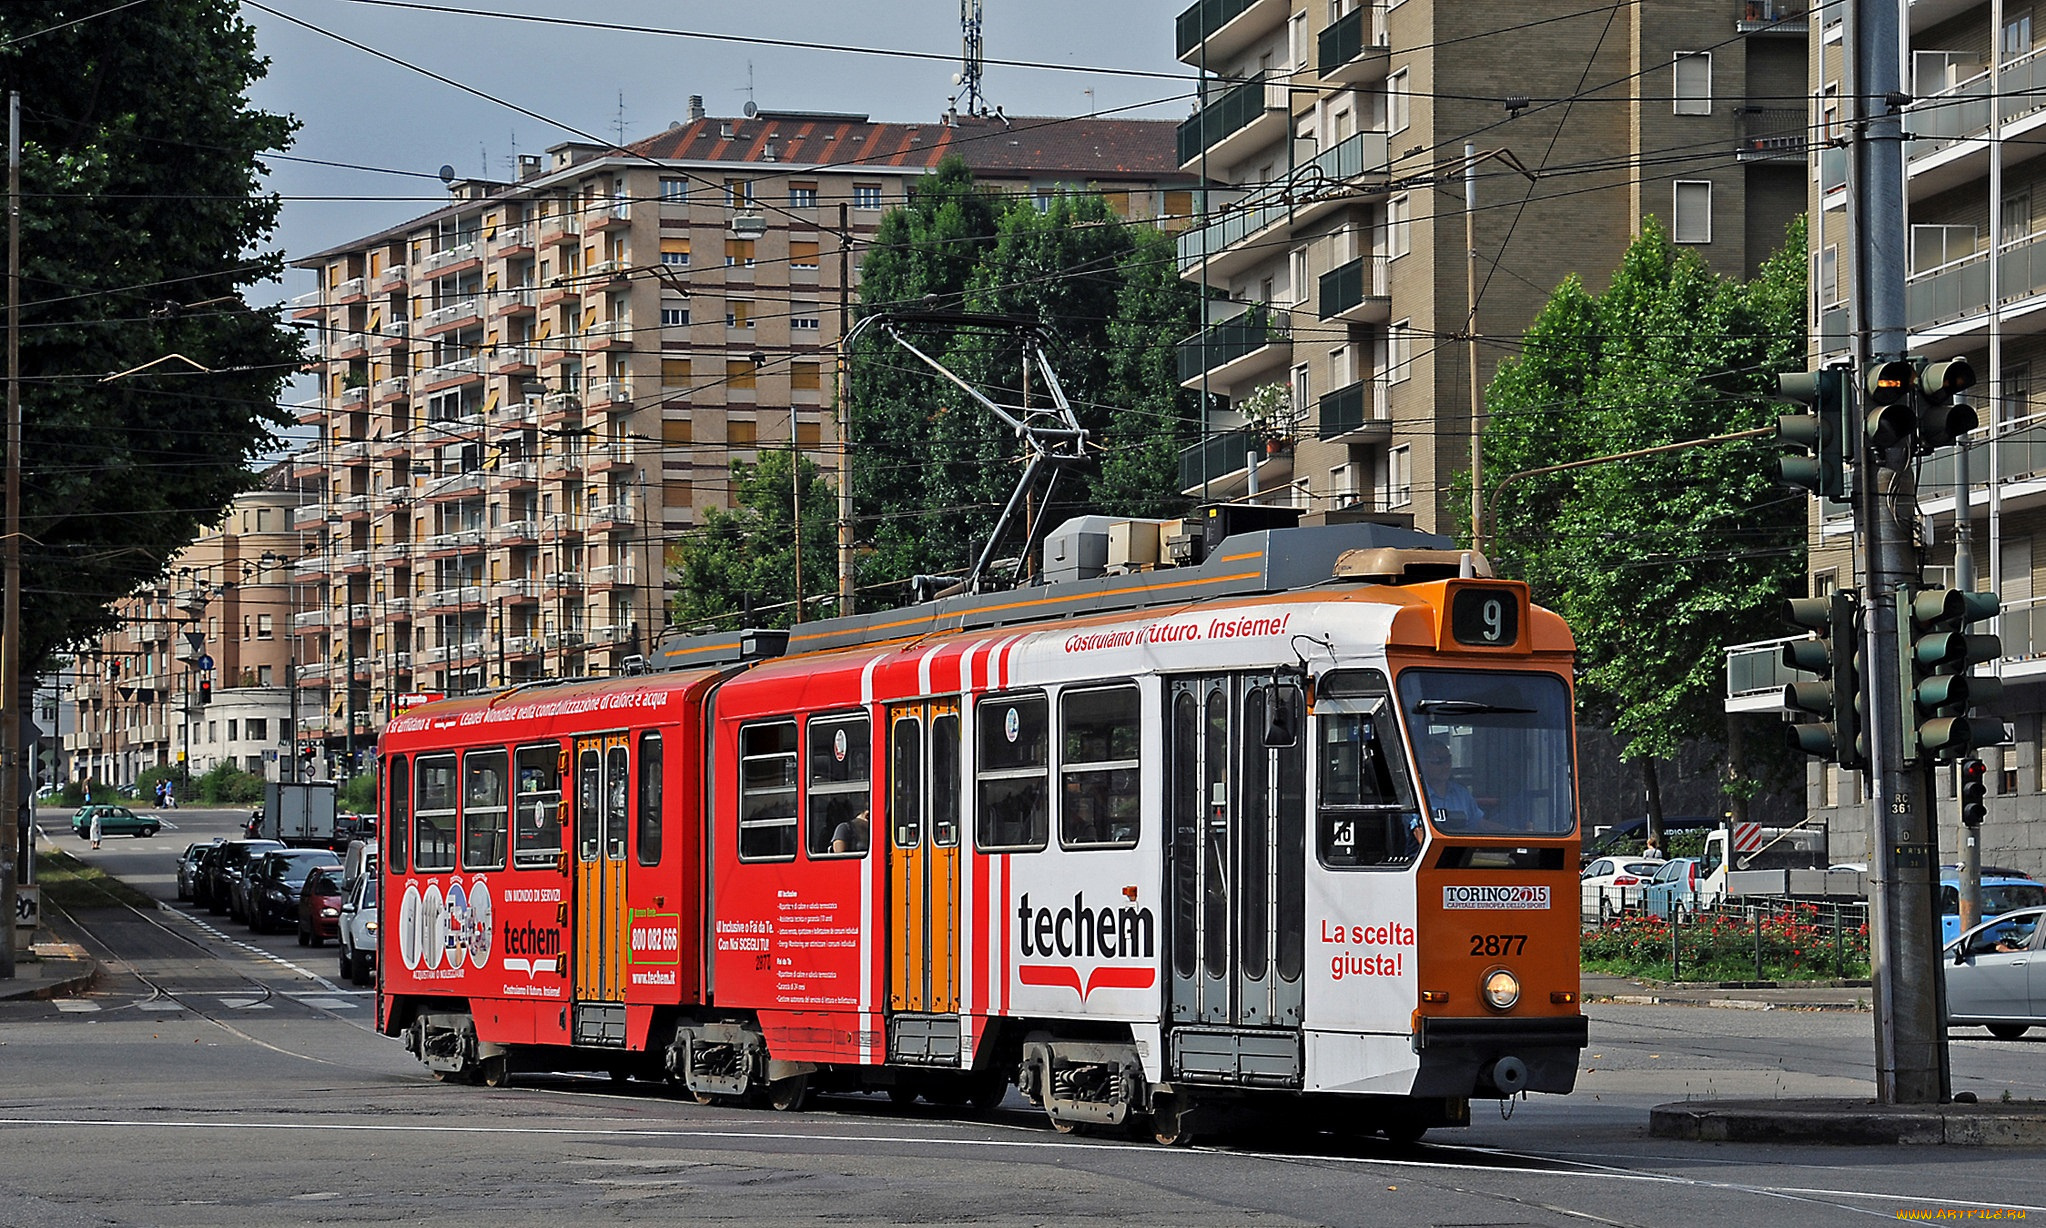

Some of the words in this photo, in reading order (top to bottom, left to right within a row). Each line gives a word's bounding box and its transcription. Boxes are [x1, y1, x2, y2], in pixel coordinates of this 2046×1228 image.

[1065, 630, 1134, 653] Costruiamo
[1207, 613, 1291, 639] Insieme!
[1483, 599, 1501, 641] 9
[642, 691, 668, 710] acqua
[1895, 794, 1908, 803] RC
[1903, 831, 1910, 841] D
[504, 920, 560, 955] techem
[1018, 891, 1154, 958] techem
[1321, 919, 1345, 943] La
[1351, 921, 1414, 946] scelta
[1470, 935, 1528, 956] 2877
[632, 970, 676, 985] www.techem.it
[1331, 952, 1403, 981] giusta!
